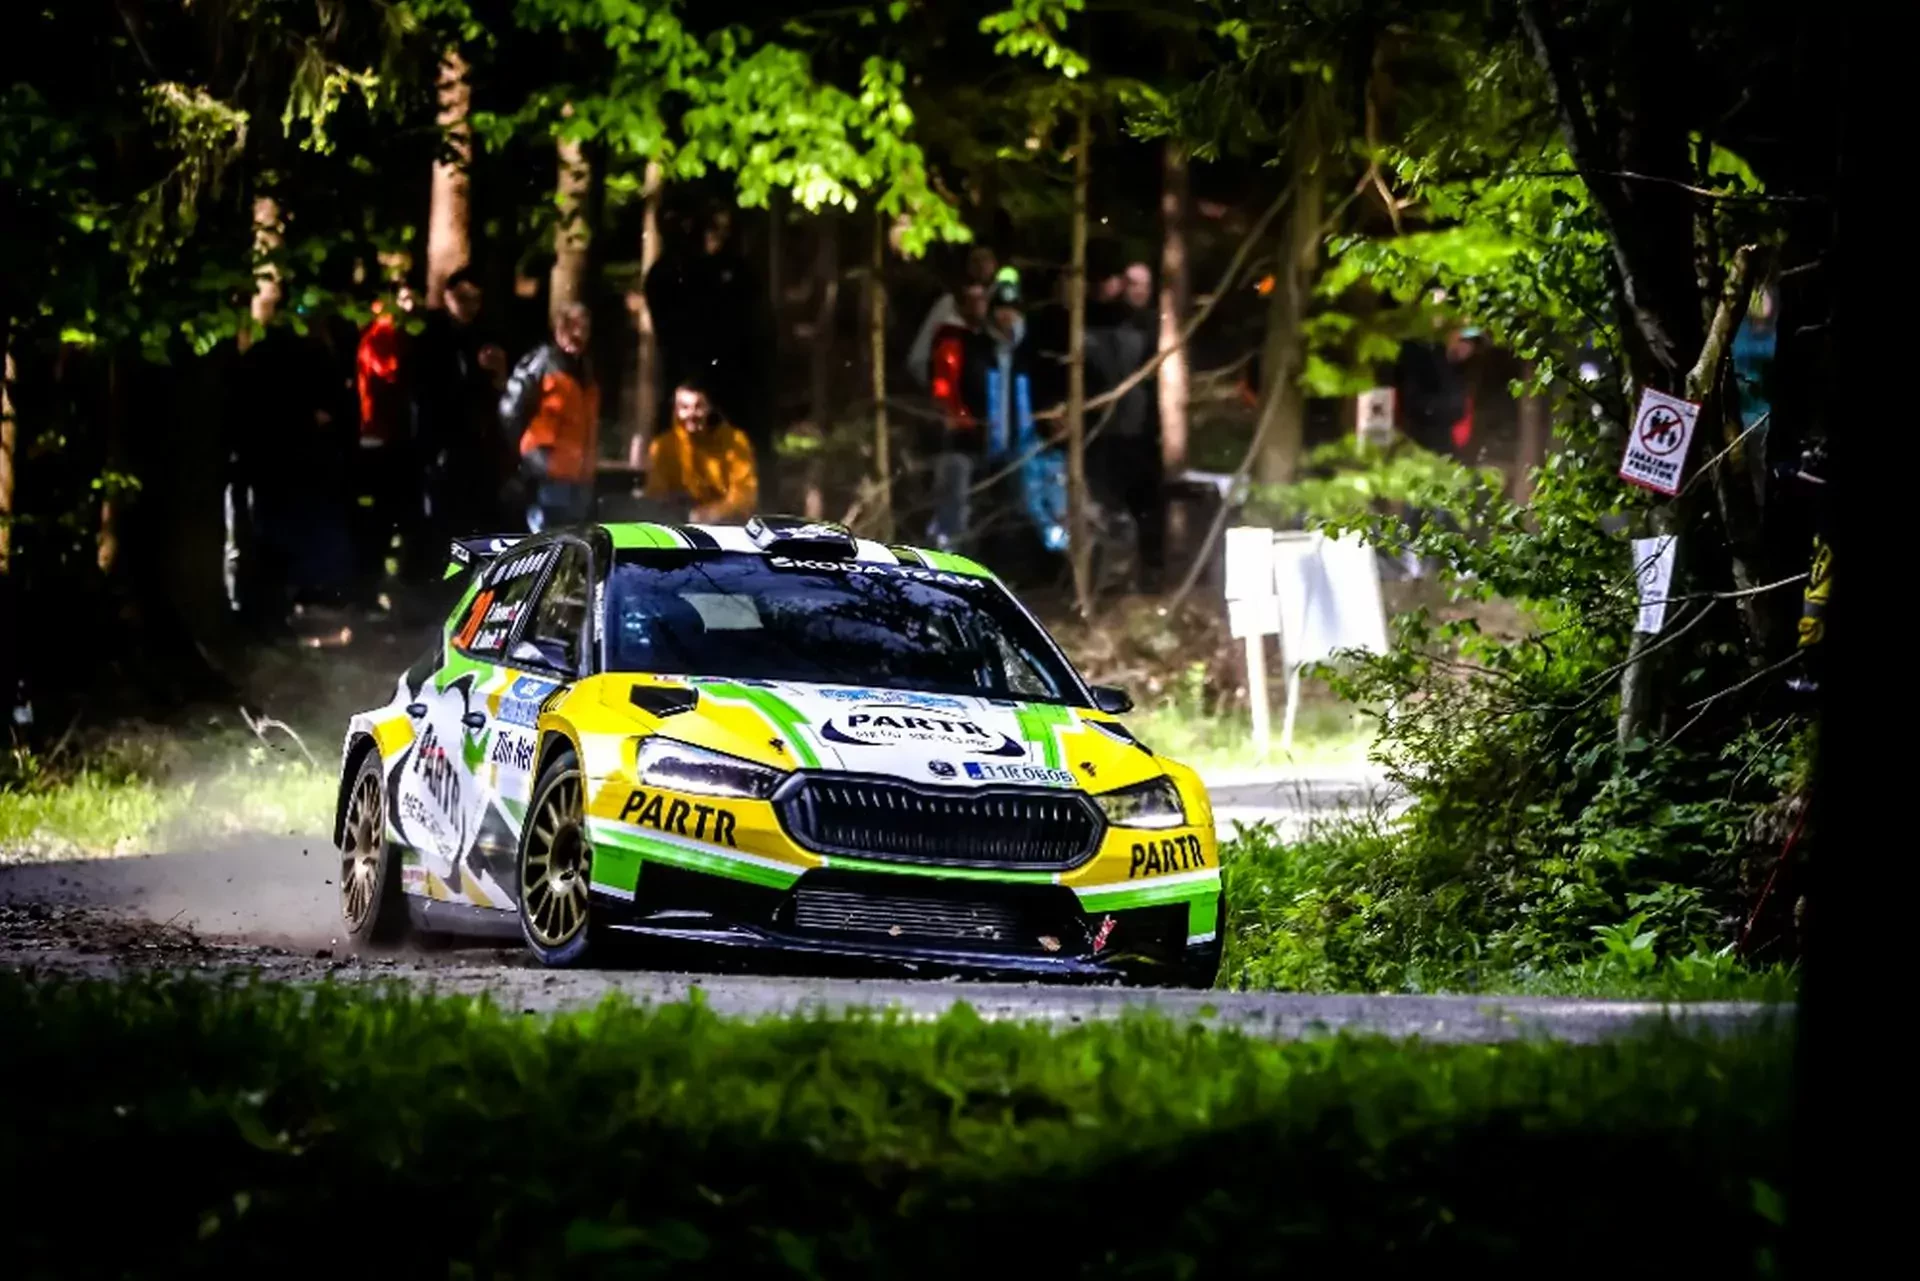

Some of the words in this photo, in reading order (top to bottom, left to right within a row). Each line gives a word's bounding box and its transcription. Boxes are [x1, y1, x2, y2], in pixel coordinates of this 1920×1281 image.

[892, 567, 985, 588] TEAM
[848, 714, 991, 738] PARTR
[619, 790, 737, 848] PARTR
[1129, 834, 1206, 879] PARTR
